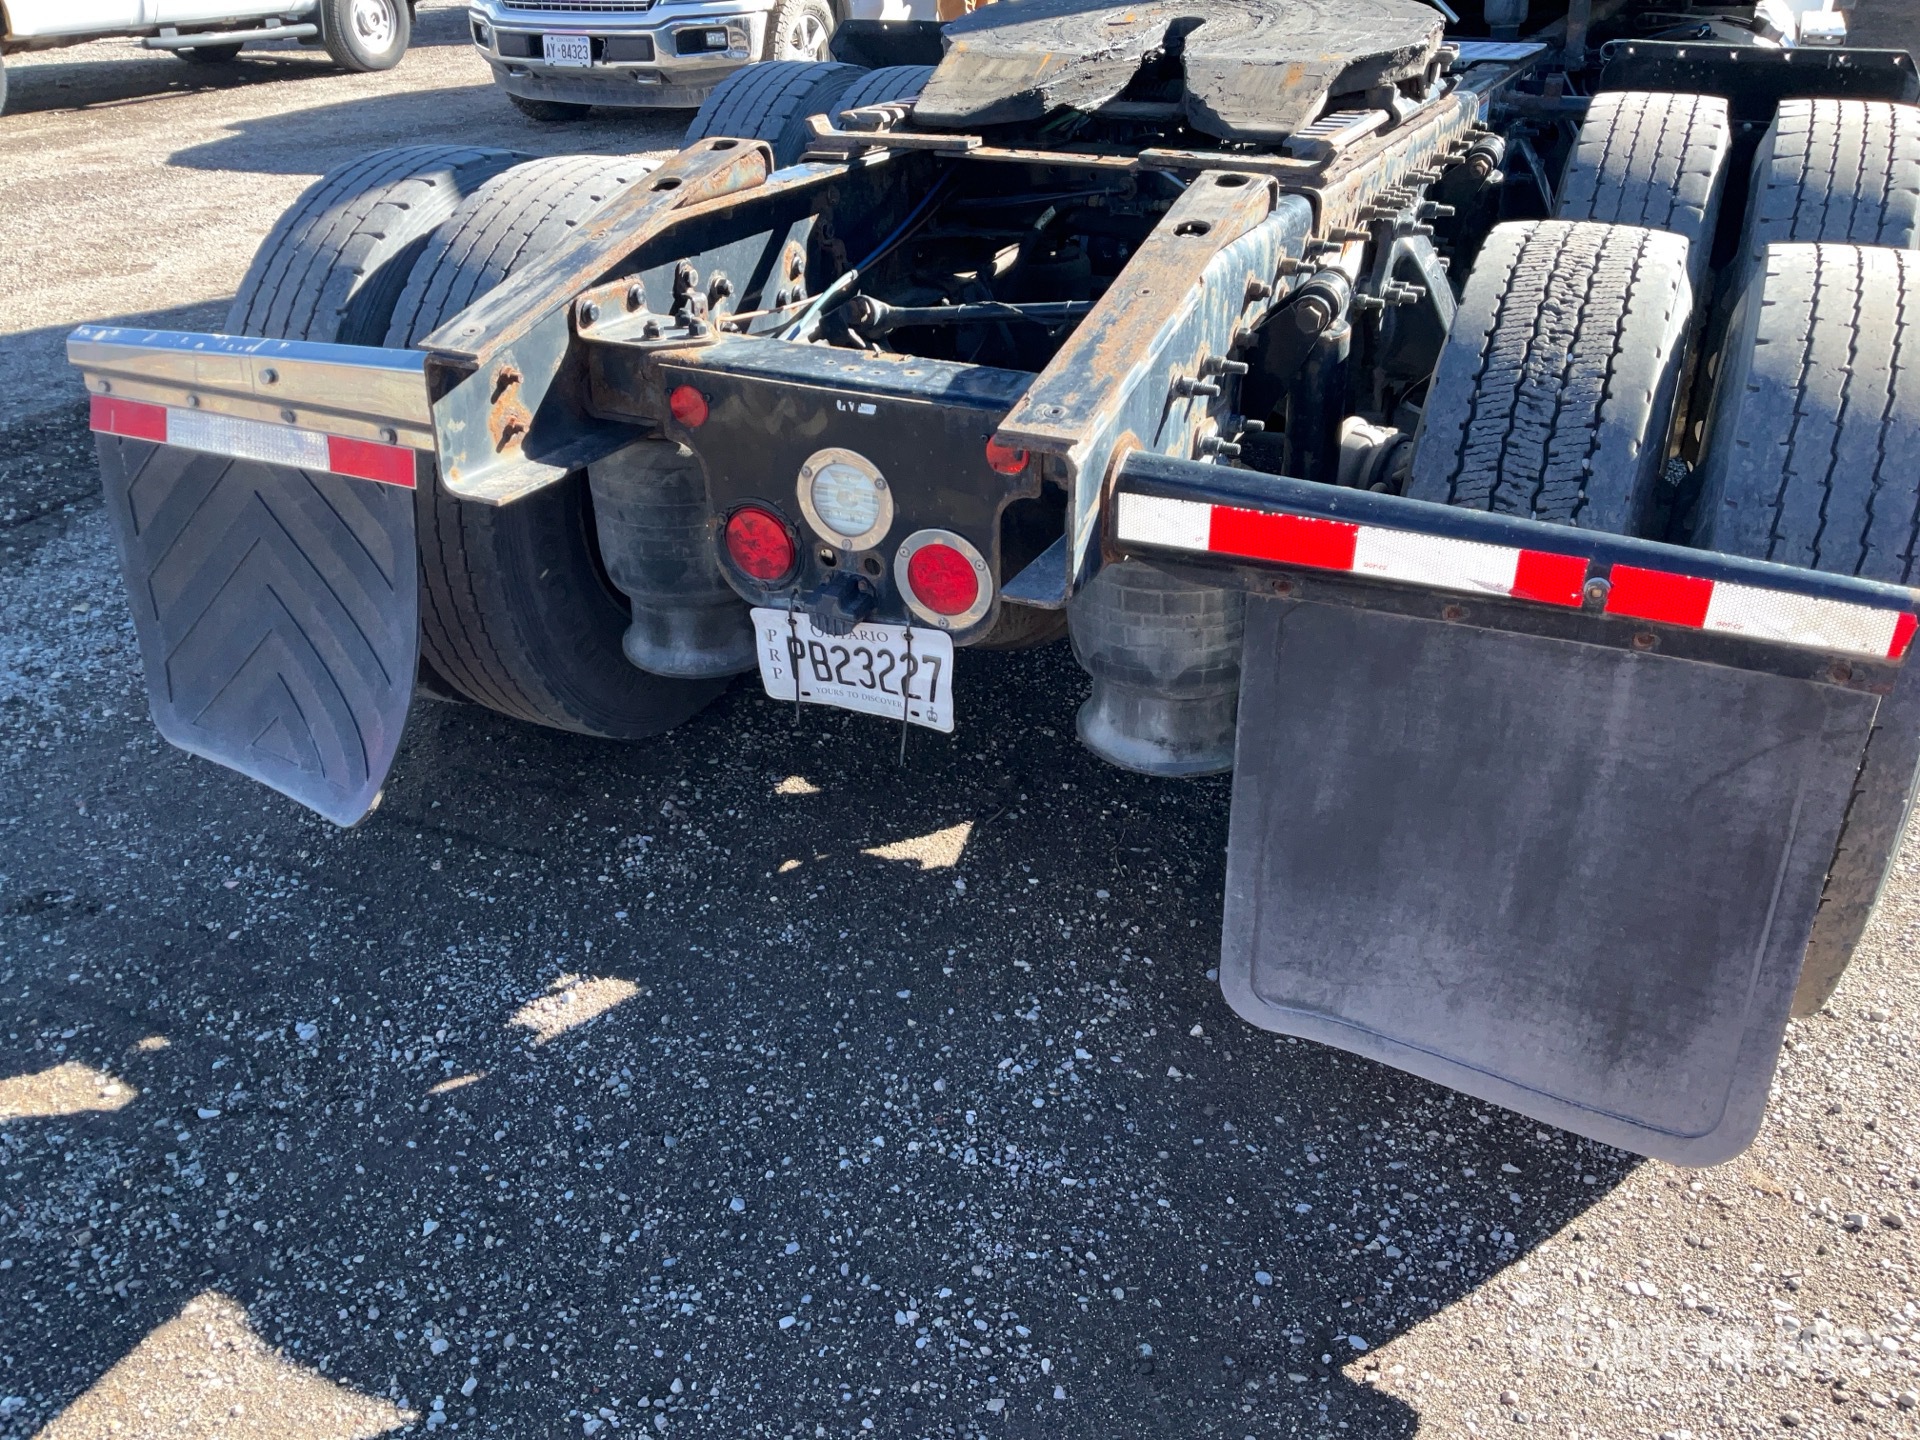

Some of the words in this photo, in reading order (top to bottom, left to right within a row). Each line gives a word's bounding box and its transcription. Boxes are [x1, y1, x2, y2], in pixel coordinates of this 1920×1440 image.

[546, 43, 555, 58] AY
[561, 43, 589, 60] 84323
[811, 625, 889, 644] OARIO
[786, 635, 942, 703] PB23227
[816, 686, 845, 697] YOURS
[847, 690, 859, 699] TO
[861, 693, 903, 709] DISCOVER
